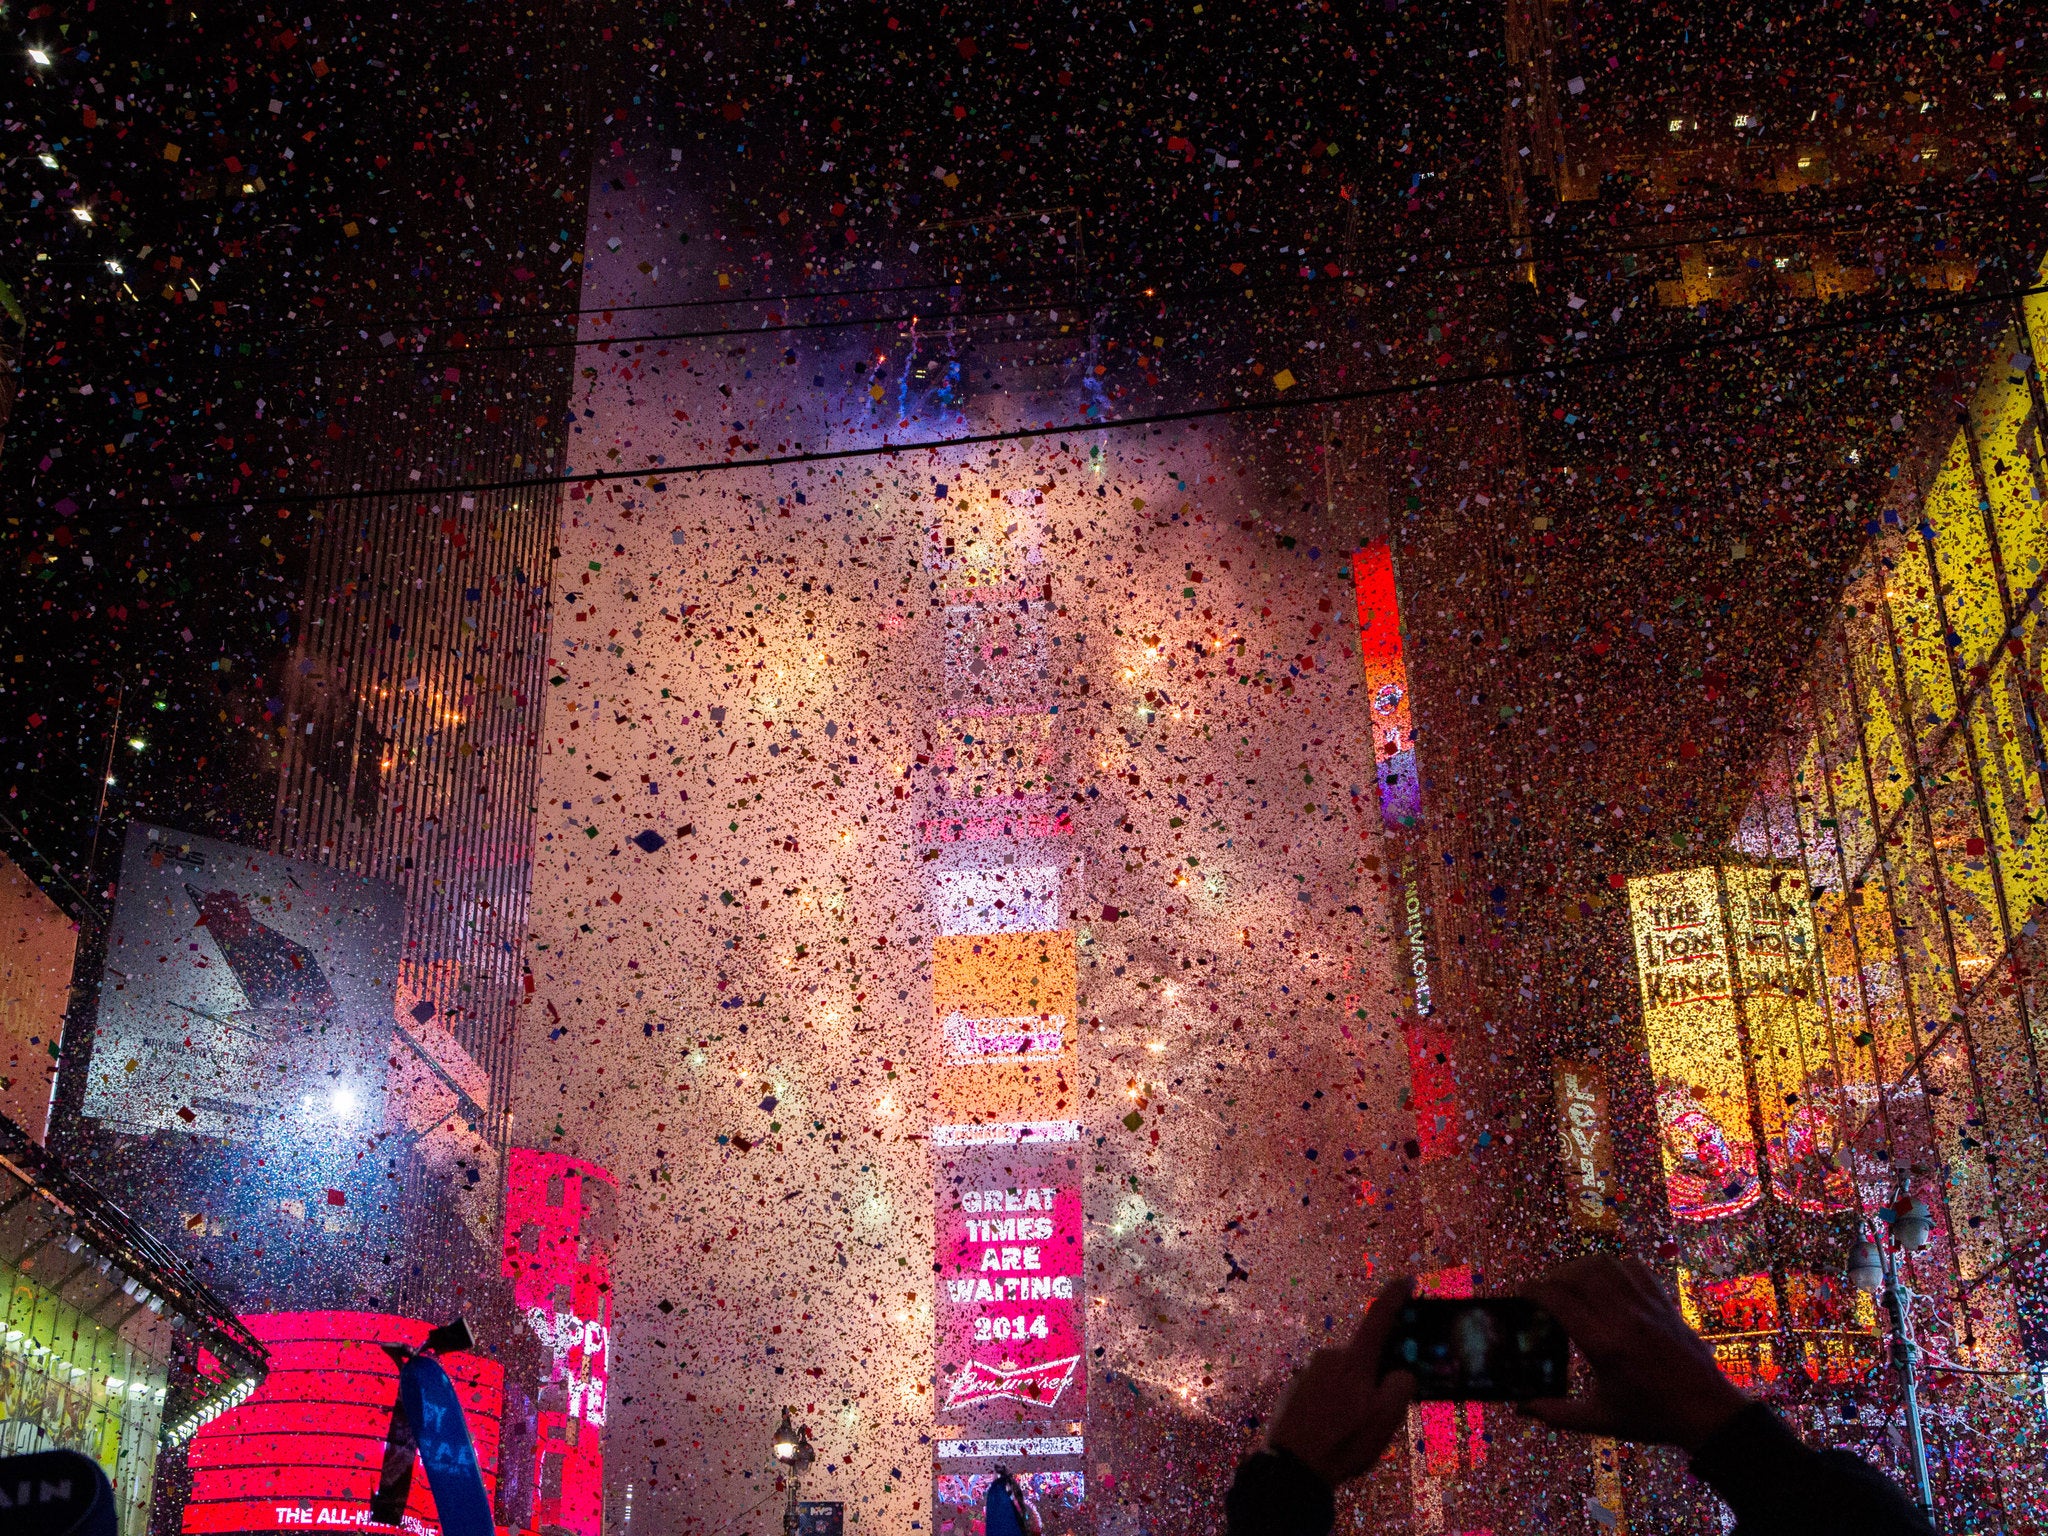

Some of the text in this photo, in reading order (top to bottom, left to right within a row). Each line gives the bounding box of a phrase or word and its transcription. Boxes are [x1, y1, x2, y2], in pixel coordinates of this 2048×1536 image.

[962, 1188, 1057, 1213] GREAT
[966, 1217, 1054, 1243] TIMES
[980, 1246, 1041, 1272] ARE
[948, 1276, 1073, 1303] WAITING
[974, 1315, 1049, 1341] 2014
[945, 1371, 1074, 1396] Budweiser
[276, 1507, 313, 1524] THE
